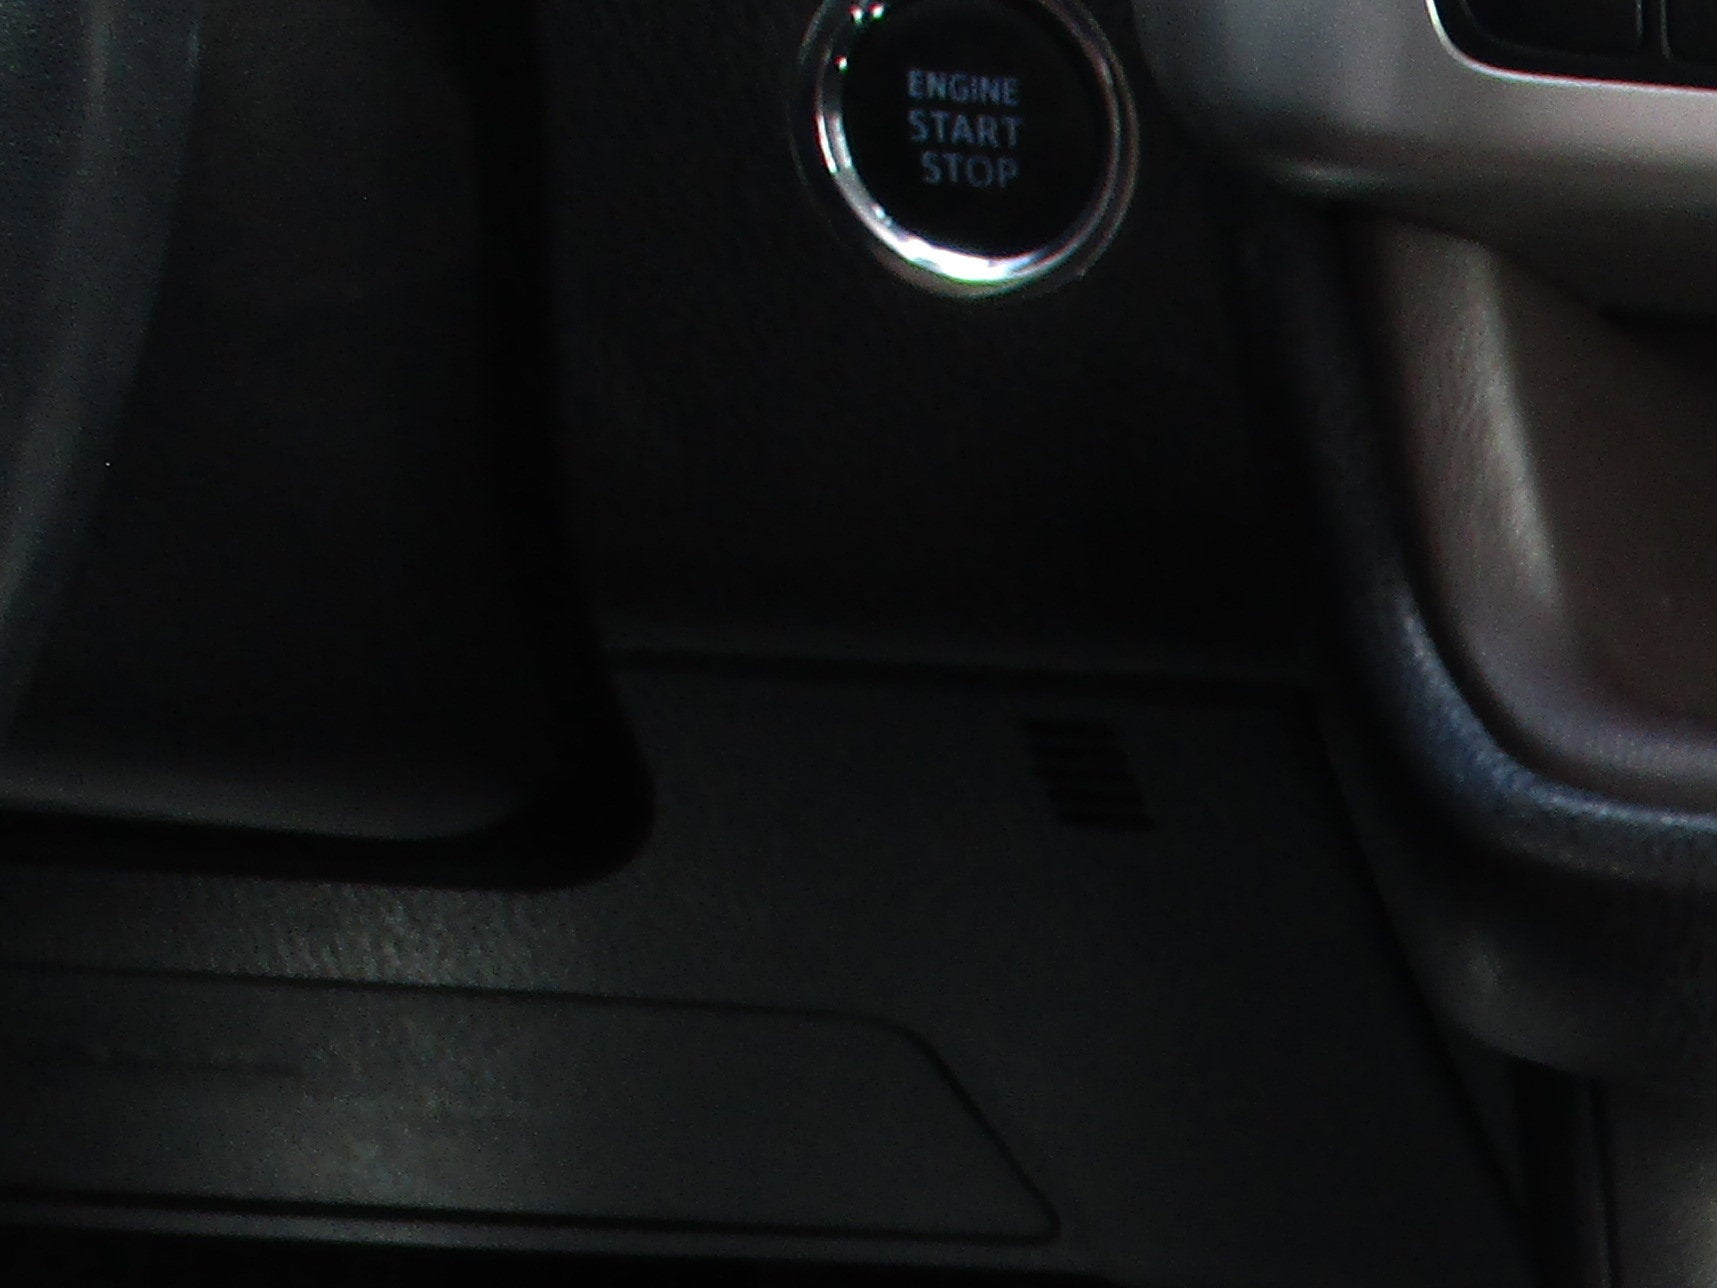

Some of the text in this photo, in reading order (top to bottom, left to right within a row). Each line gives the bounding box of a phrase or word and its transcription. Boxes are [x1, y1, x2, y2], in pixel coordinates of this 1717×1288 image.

[907, 70, 1020, 106] ENGINE
[907, 109, 1023, 147] START
[920, 150, 1021, 188] STOP
